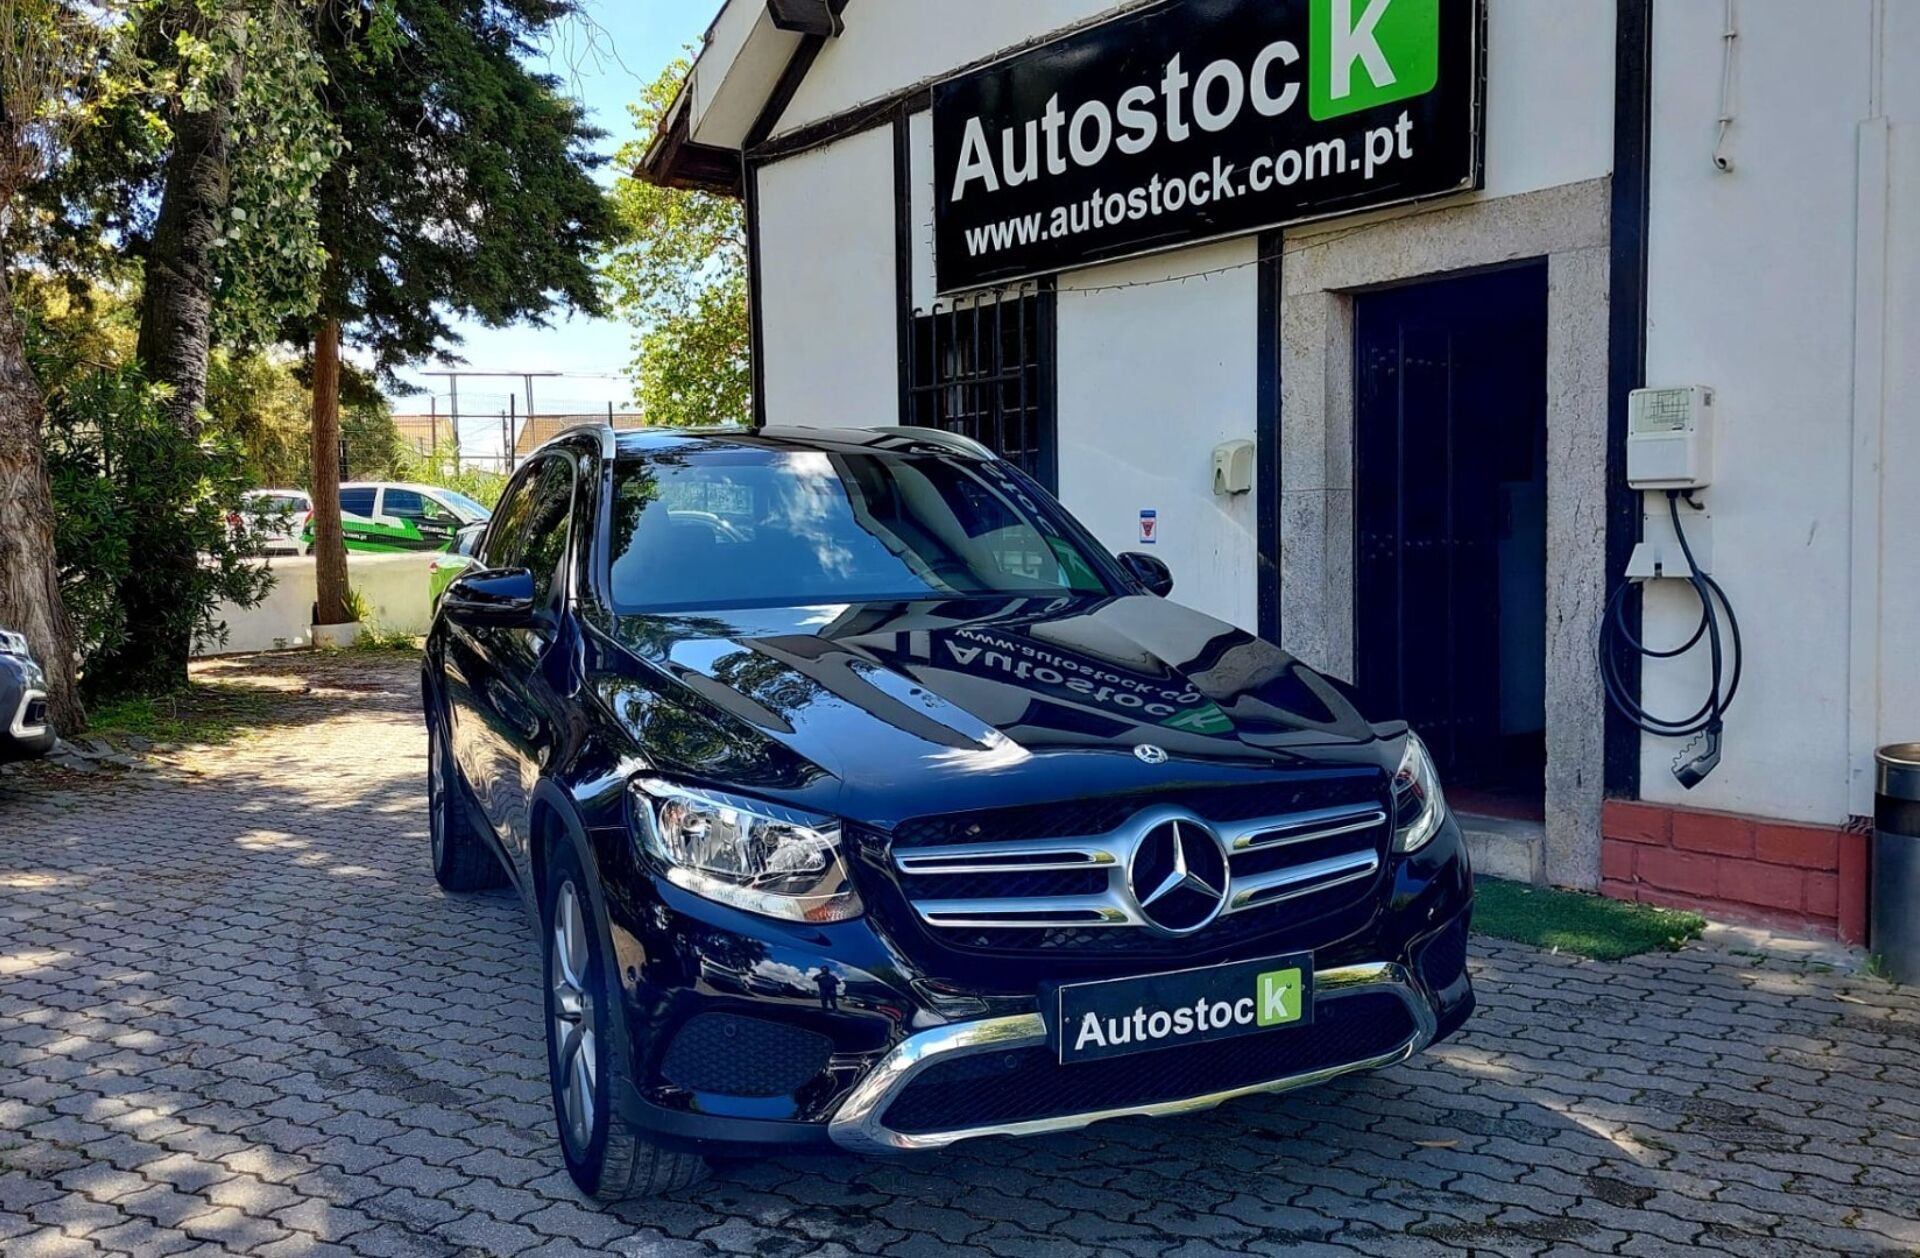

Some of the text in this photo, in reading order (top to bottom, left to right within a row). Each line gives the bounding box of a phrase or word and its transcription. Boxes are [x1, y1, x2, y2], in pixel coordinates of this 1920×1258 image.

[951, 0, 1397, 201] Autostock
[965, 110, 1414, 257] www.autostock.com.pt
[1074, 977, 1290, 1051] Autostock
